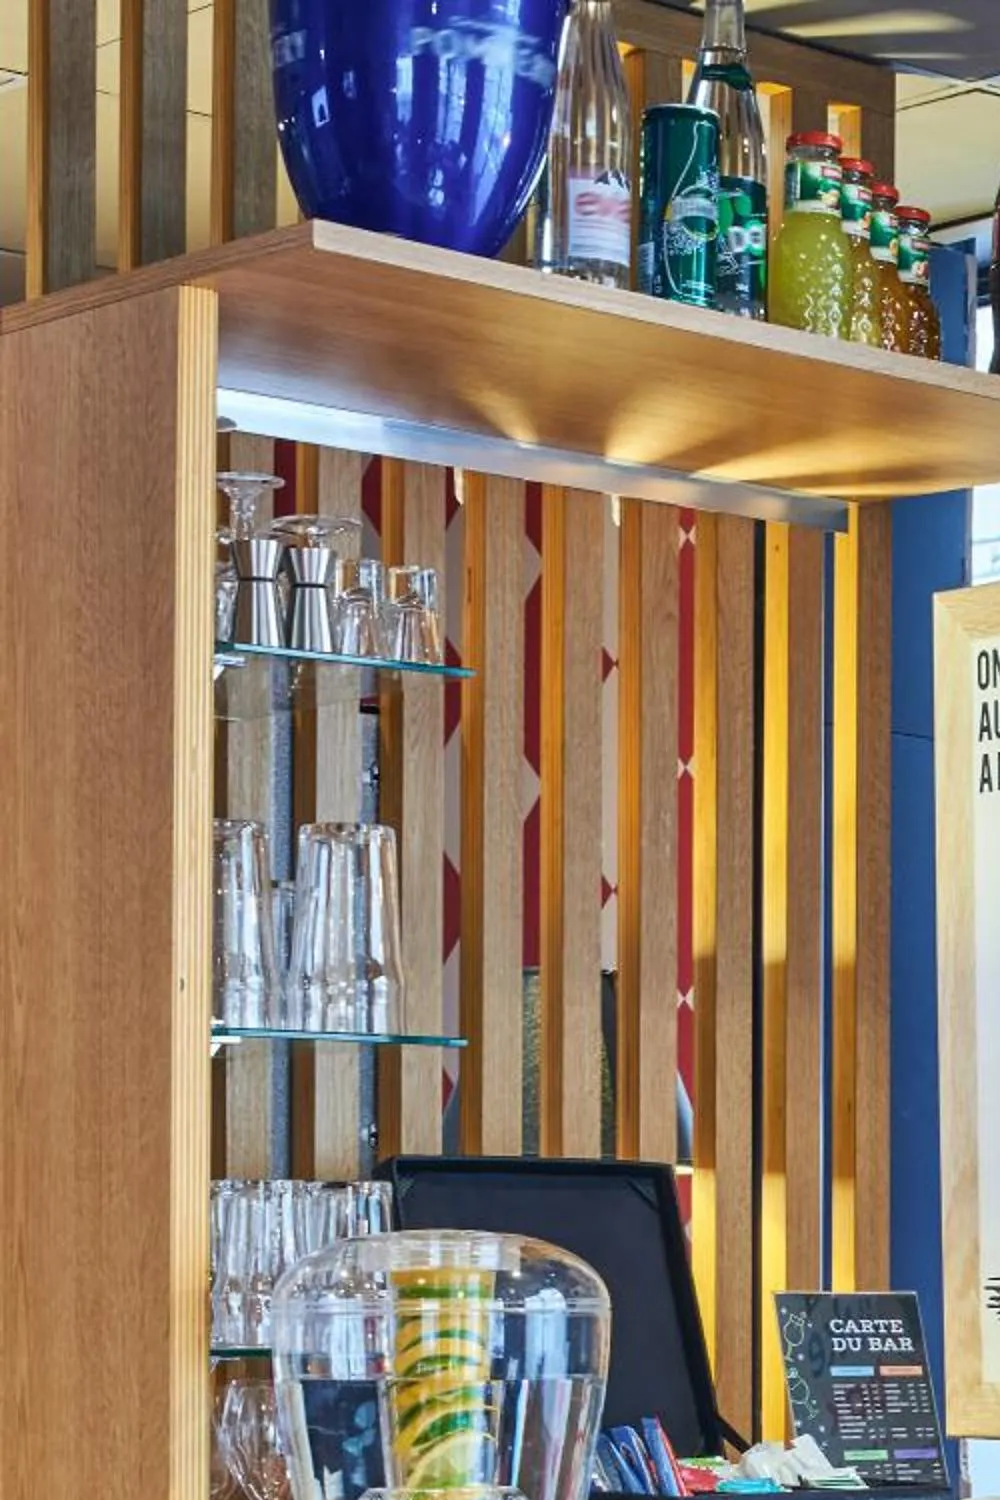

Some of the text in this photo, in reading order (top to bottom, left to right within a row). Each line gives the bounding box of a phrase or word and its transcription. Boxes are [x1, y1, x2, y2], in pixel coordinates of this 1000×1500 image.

[979, 752, 993, 793] A
[829, 1319, 904, 1333] CARTE
[832, 1337, 915, 1352] DU BAR
